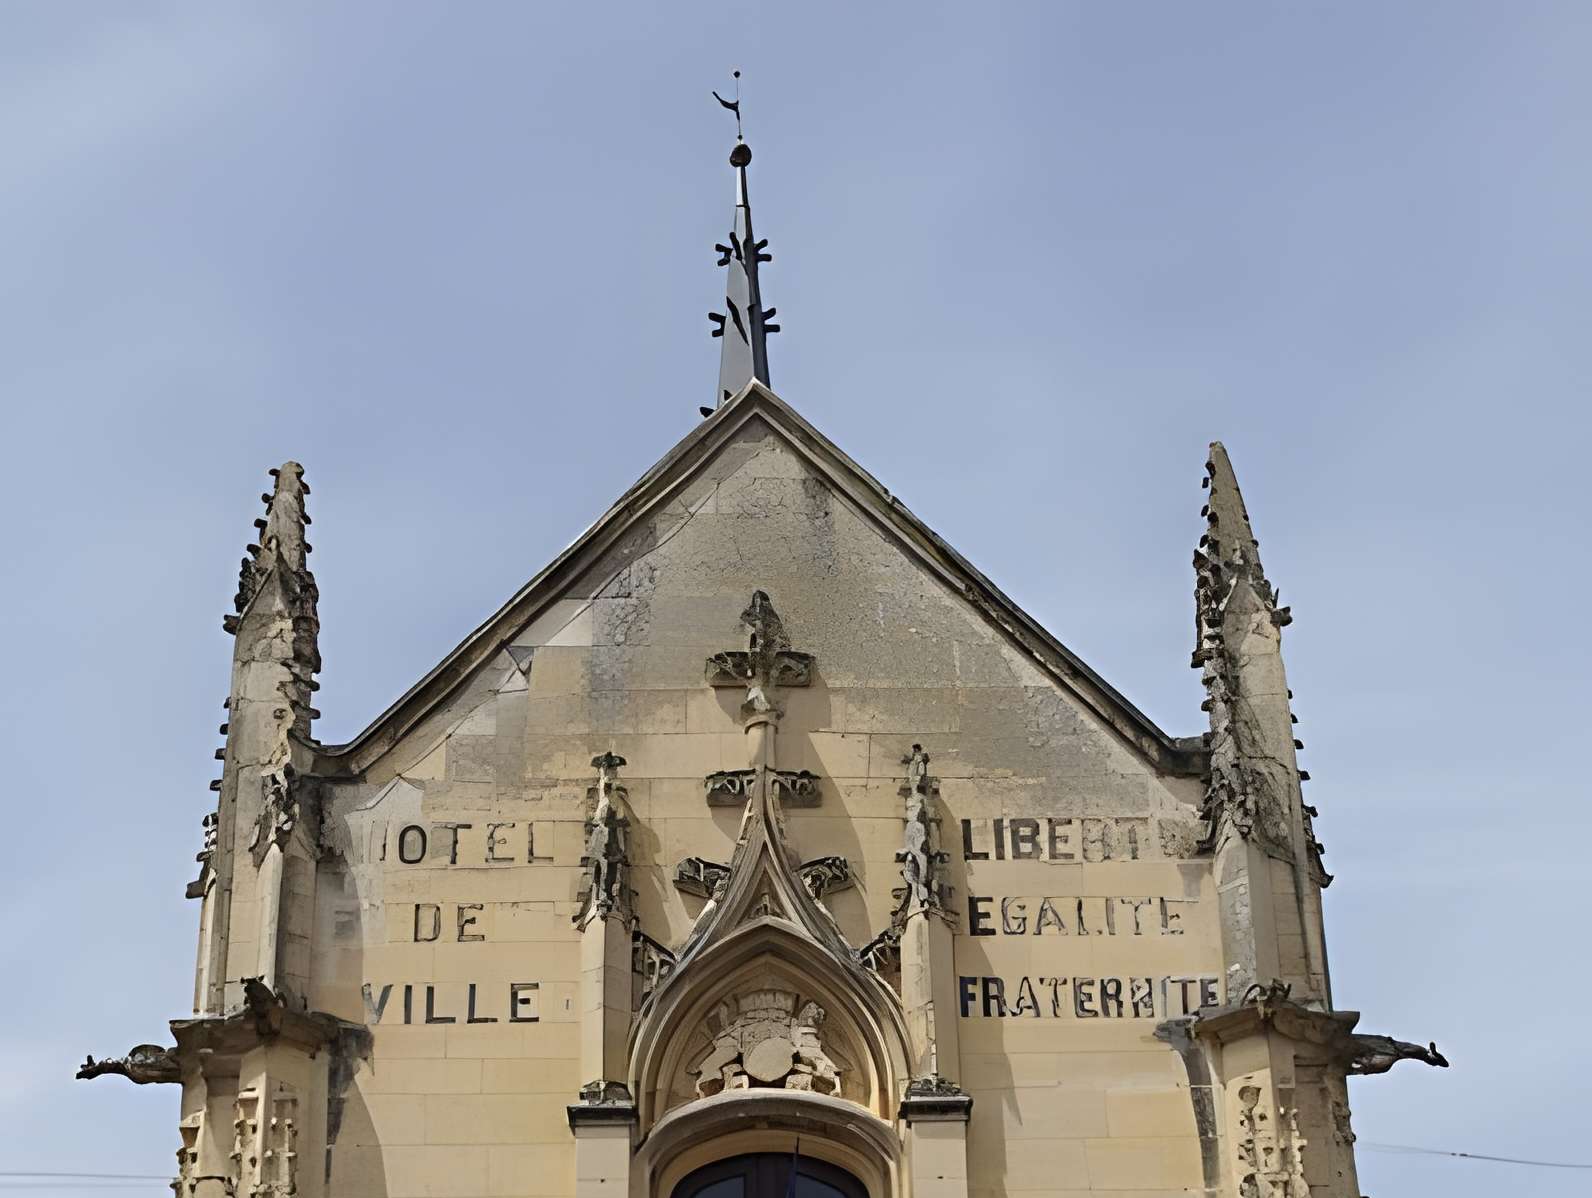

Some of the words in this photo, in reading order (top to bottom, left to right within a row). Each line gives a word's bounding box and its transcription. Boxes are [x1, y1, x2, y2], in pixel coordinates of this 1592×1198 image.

[367, 820, 554, 864] OTEL
[413, 903, 486, 942] DE
[361, 982, 540, 1024] VILLE
